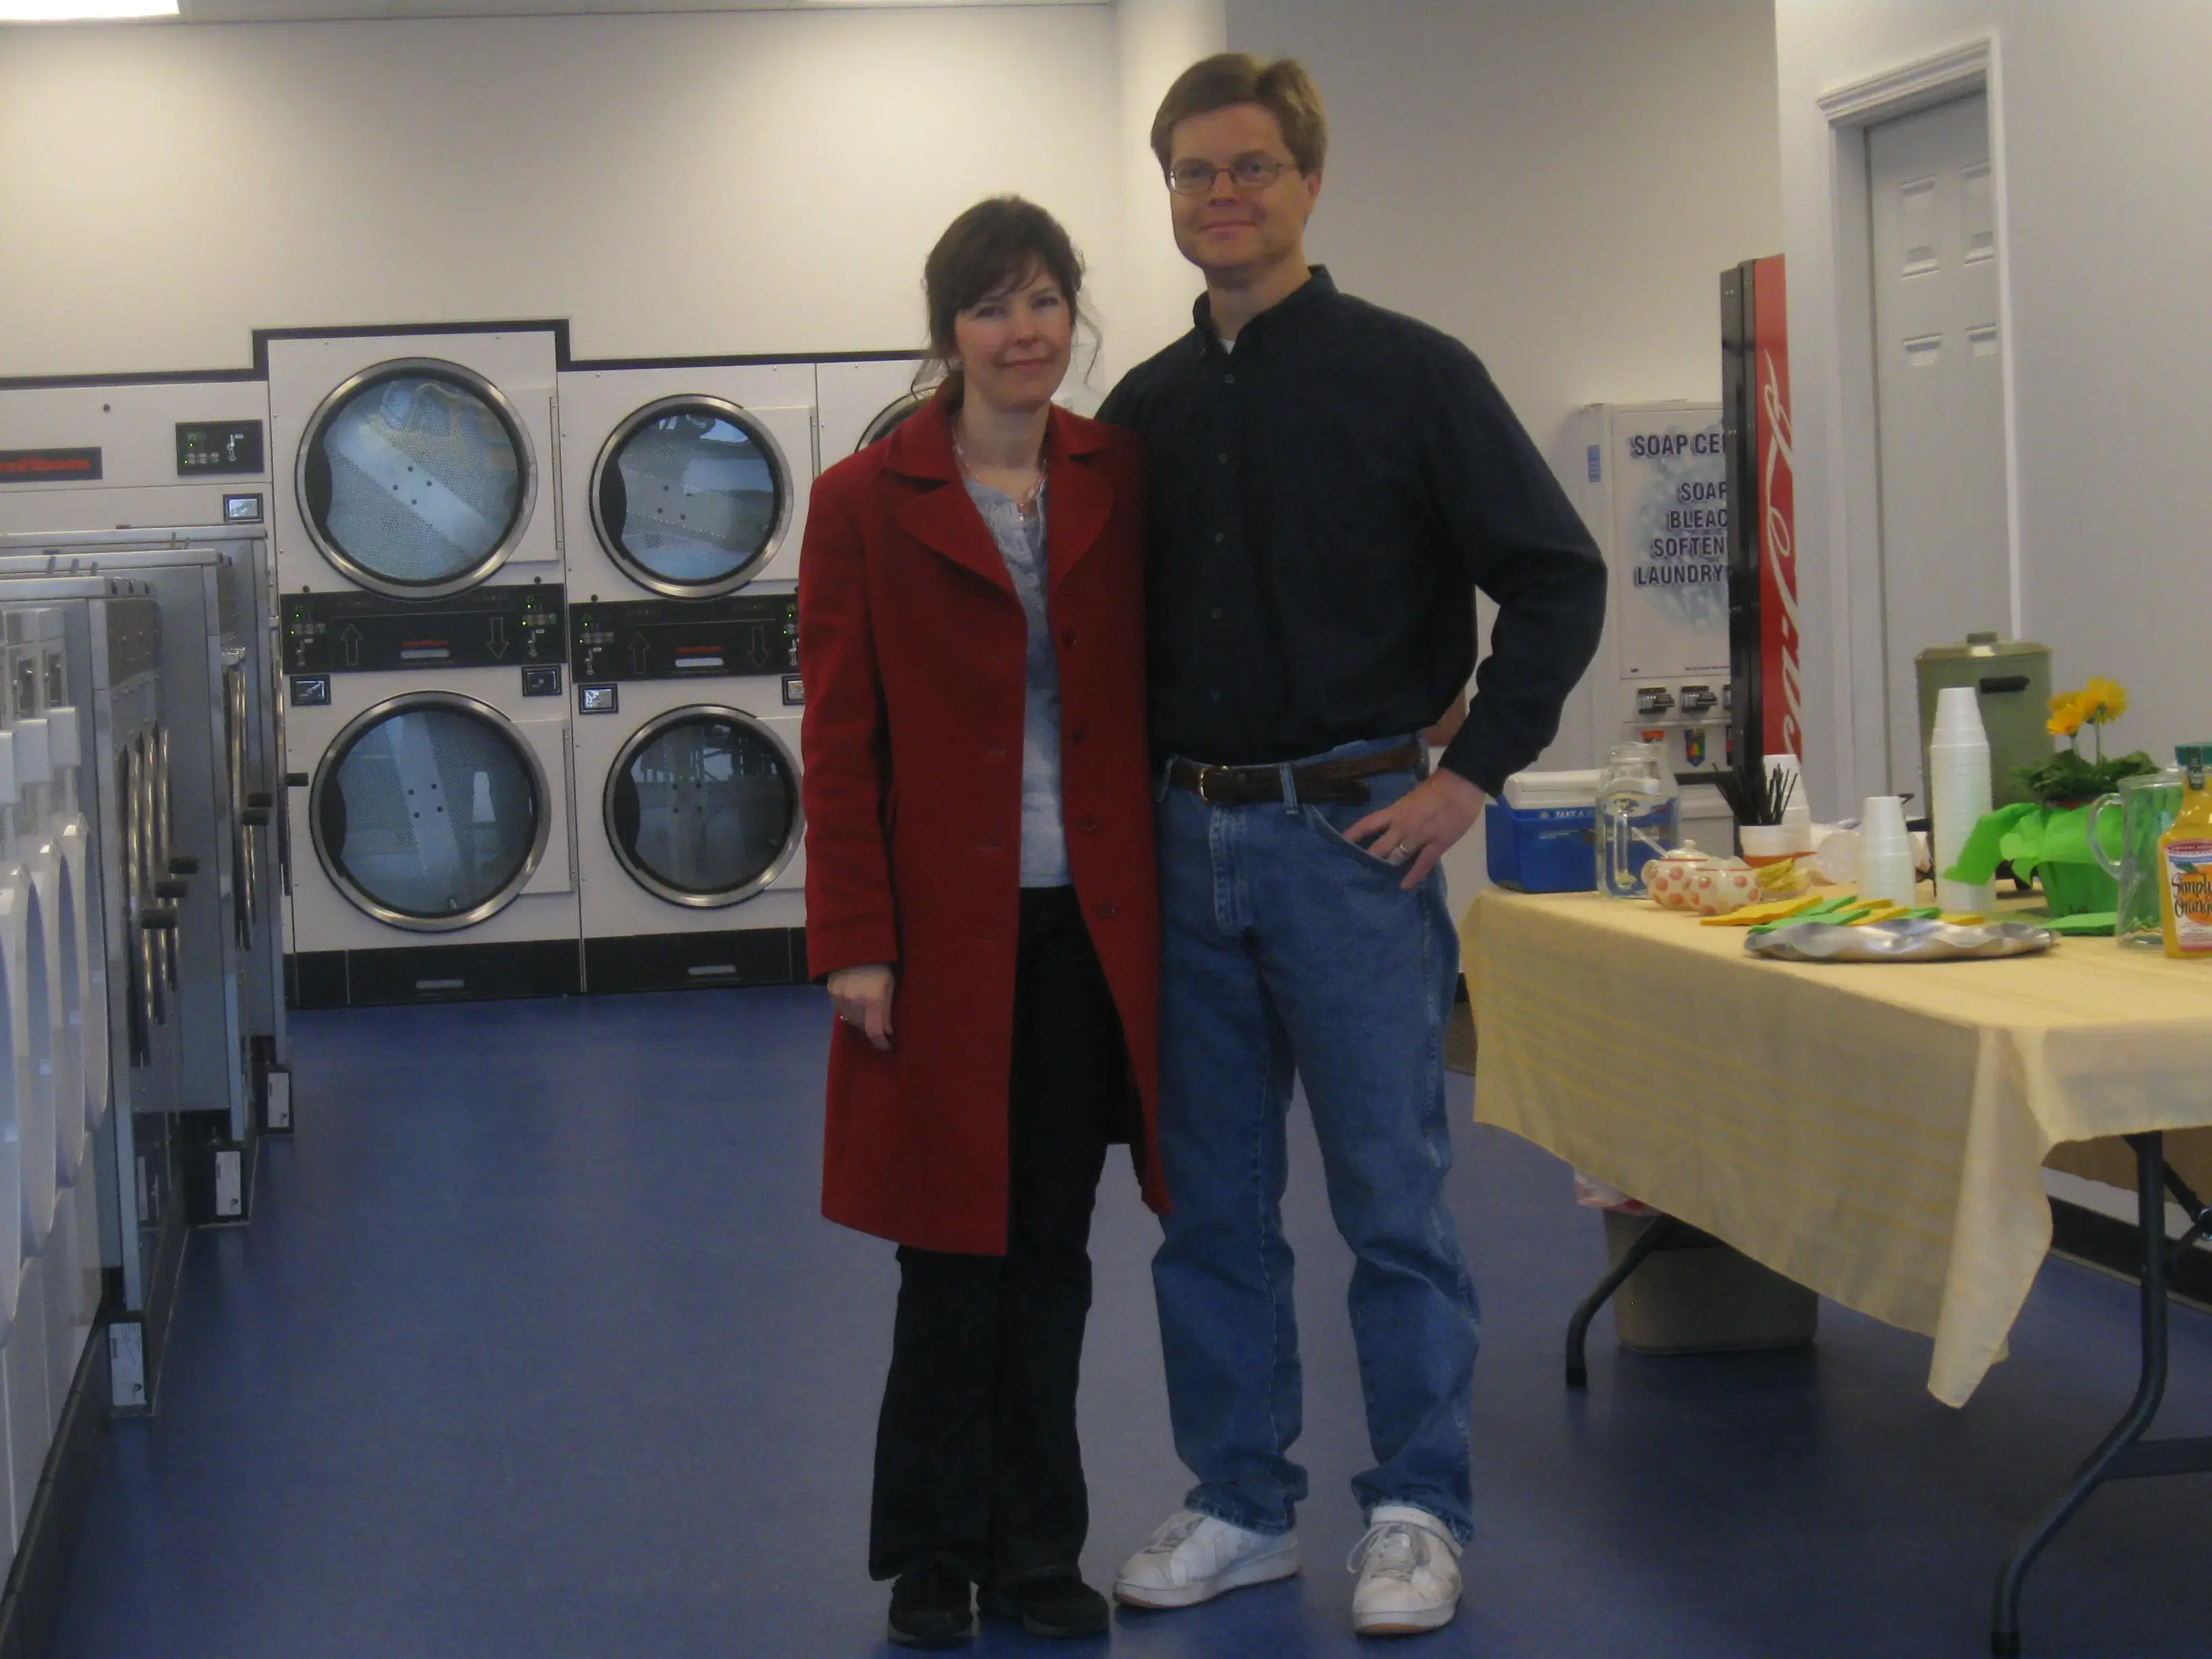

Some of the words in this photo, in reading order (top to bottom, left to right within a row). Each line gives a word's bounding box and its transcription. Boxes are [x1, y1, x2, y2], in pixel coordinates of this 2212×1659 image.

[1633, 434, 1689, 456] SOAP
[1679, 480, 1727, 501] SOAP
[1669, 508, 1727, 529] BLEAC
[1653, 536, 1725, 558] SOFTEN
[1636, 563, 1723, 585] LAUNDRY
